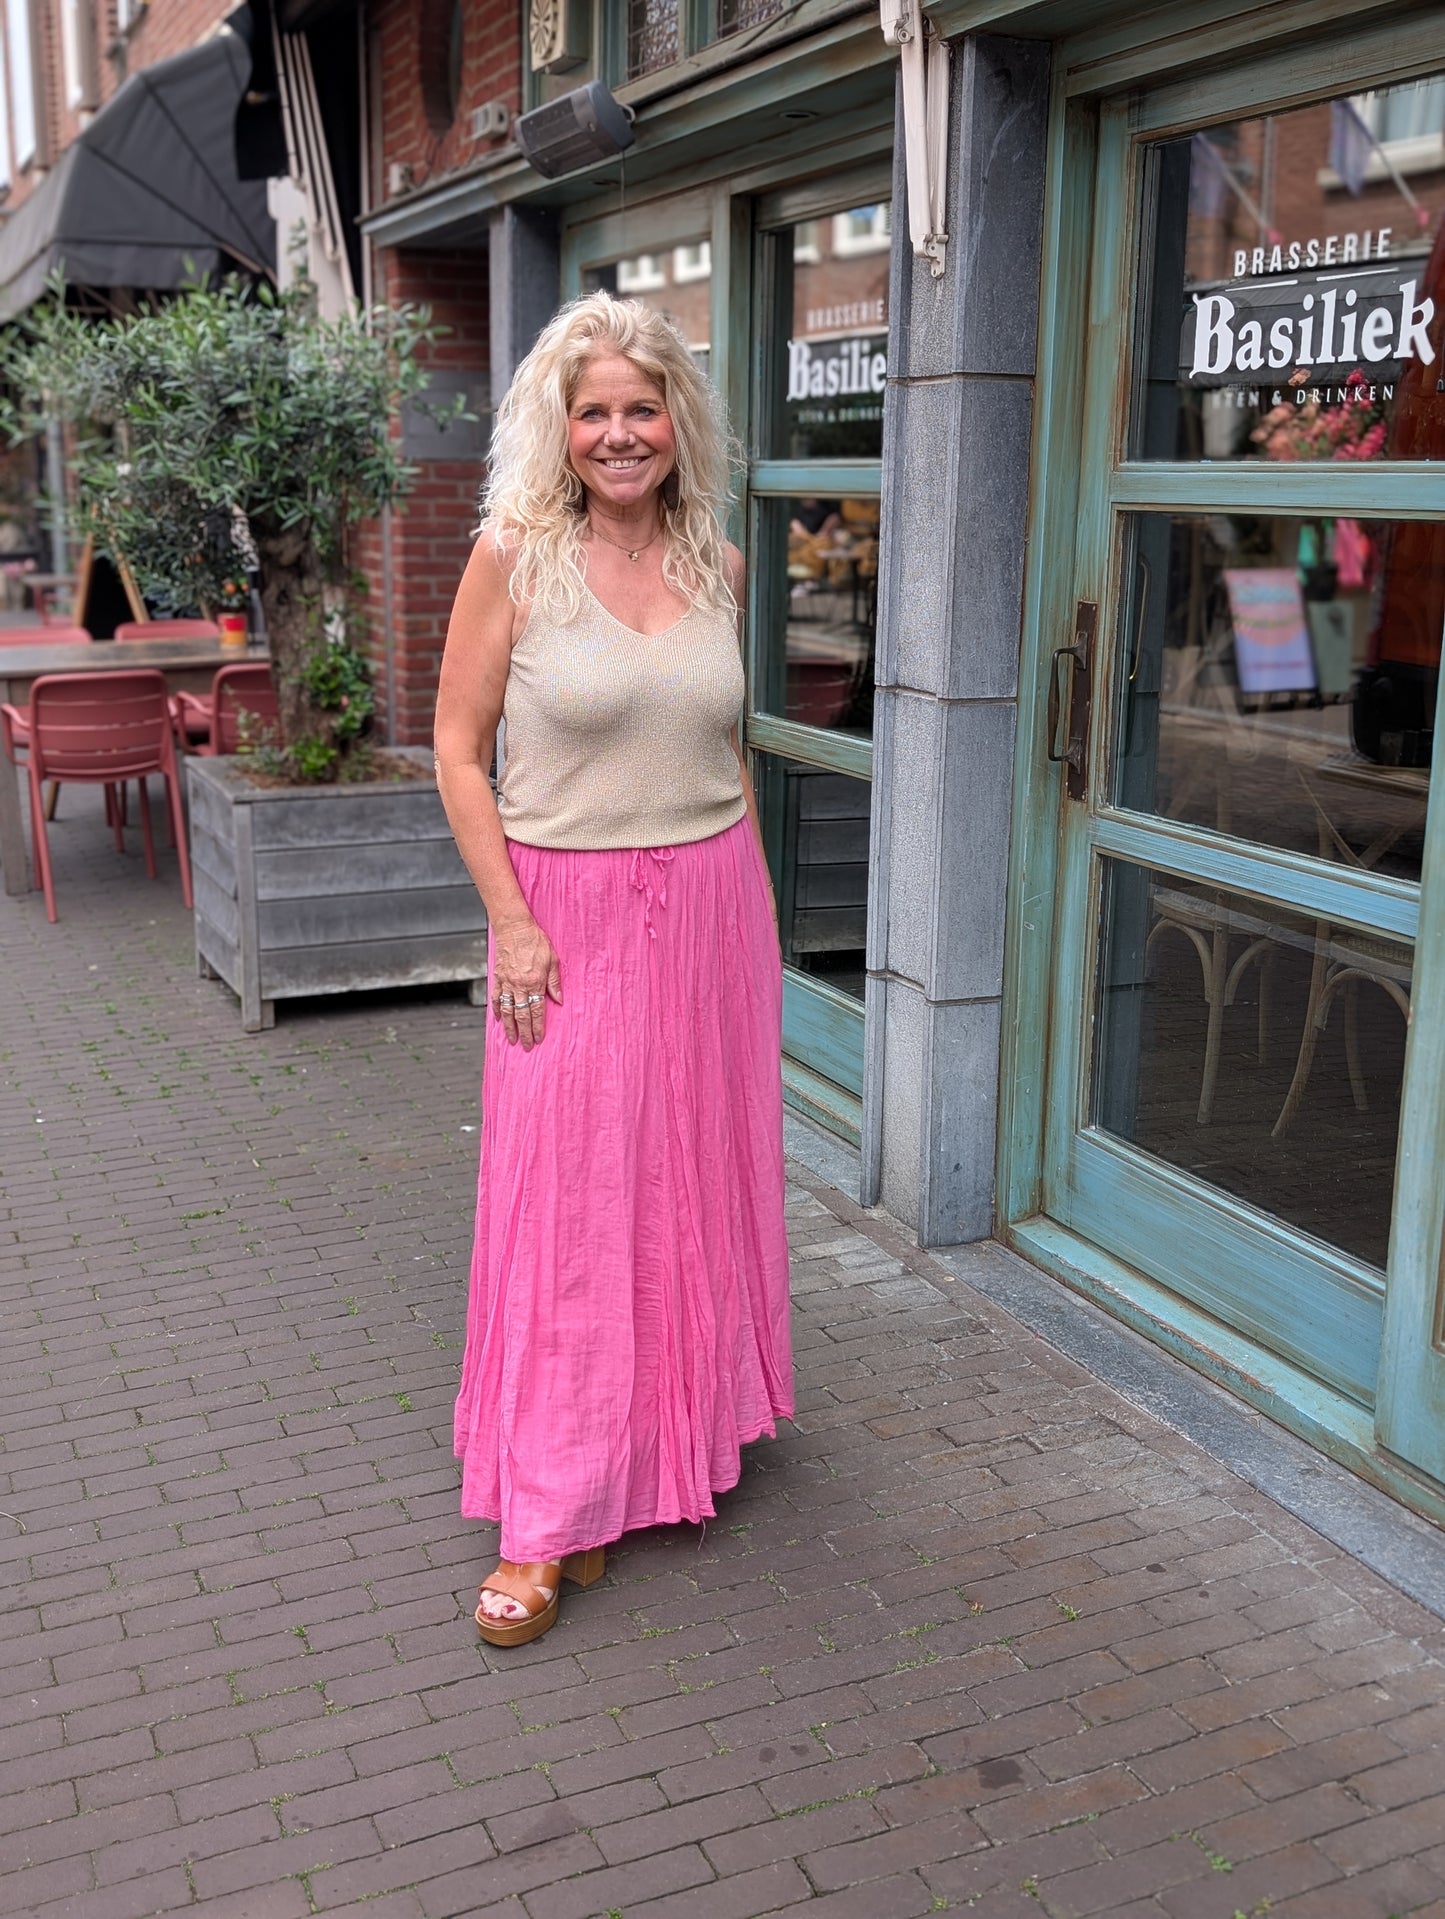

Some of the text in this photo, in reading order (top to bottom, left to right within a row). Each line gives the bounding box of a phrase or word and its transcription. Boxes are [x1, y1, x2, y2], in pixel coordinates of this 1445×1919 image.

[1234, 228, 1392, 277] BRASSERIE
[1189, 279, 1435, 379] Basiliek
[786, 339, 887, 402] Basilie
[1272, 390, 1282, 406] &
[1297, 384, 1393, 404] DRINKEN
